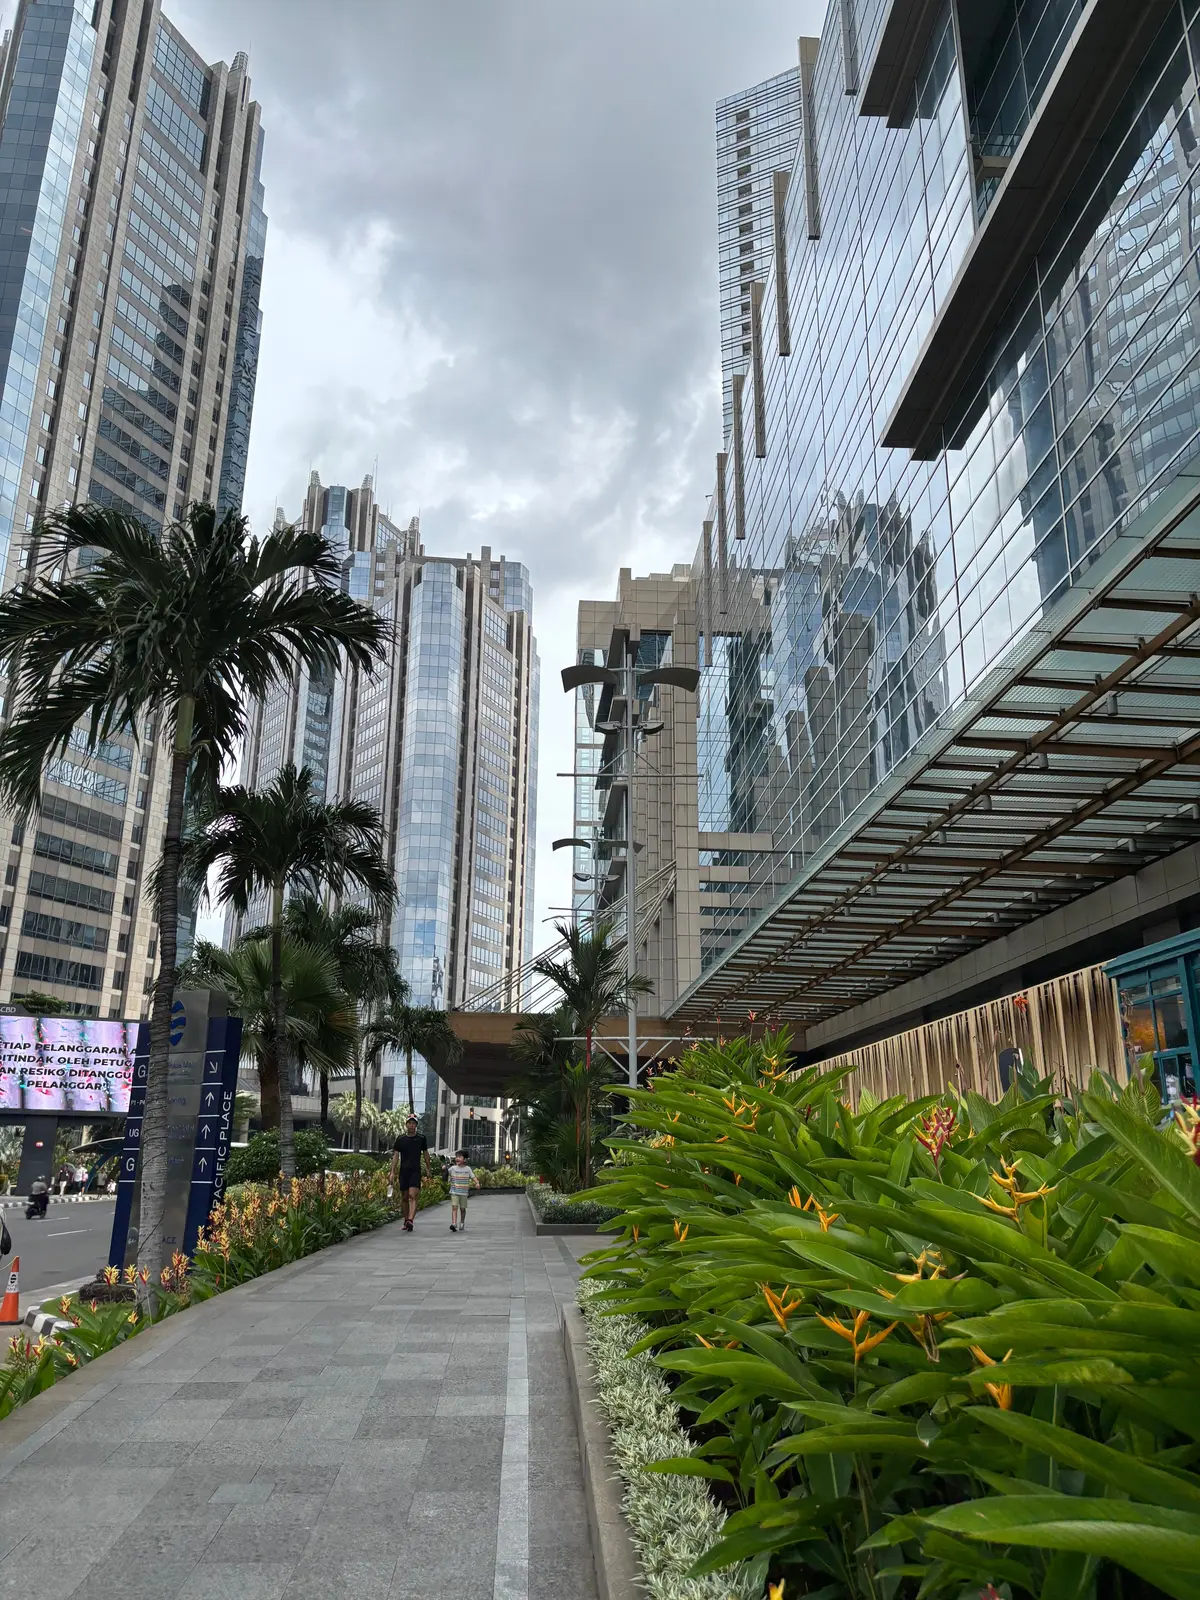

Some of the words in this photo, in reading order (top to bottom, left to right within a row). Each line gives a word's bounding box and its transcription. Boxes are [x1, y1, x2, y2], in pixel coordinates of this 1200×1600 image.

[35, 1042, 126, 1055] PELANGGARAN
[0, 1054, 53, 1064] ITINDAK
[57, 1056, 90, 1065] OLEH
[93, 1058, 134, 1067] PETUG
[20, 1067, 65, 1077] RESIKO
[69, 1069, 131, 1079] DITANGGU
[219, 1091, 233, 1141] PLACE
[128, 1128, 140, 1138] UG
[126, 1157, 135, 1172] G
[212, 1146, 227, 1209] PACIFIC
